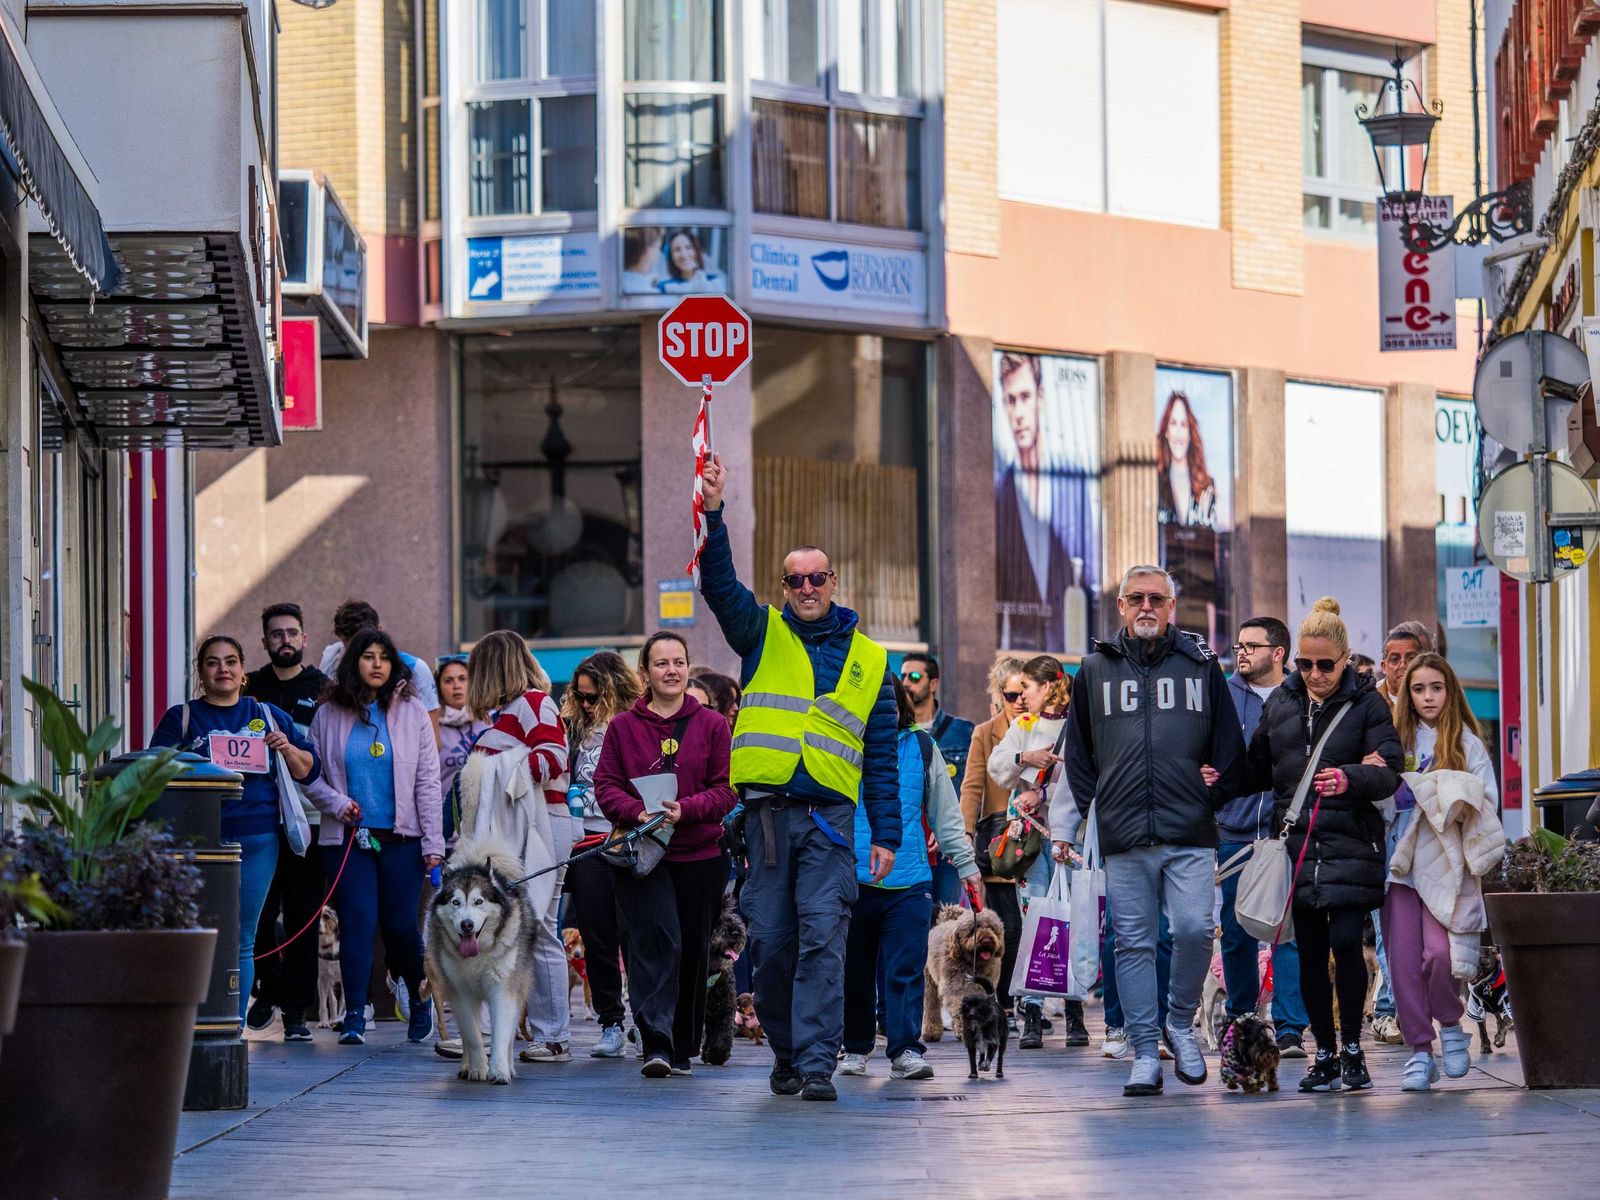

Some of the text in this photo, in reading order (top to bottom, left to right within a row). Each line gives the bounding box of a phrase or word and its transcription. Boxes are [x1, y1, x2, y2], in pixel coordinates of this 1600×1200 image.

[752, 269, 799, 293] Dental
[666, 321, 745, 358] STOP
[1462, 568, 1484, 590] DAT
[1103, 677, 1203, 716] ICON
[228, 739, 251, 758] 02
